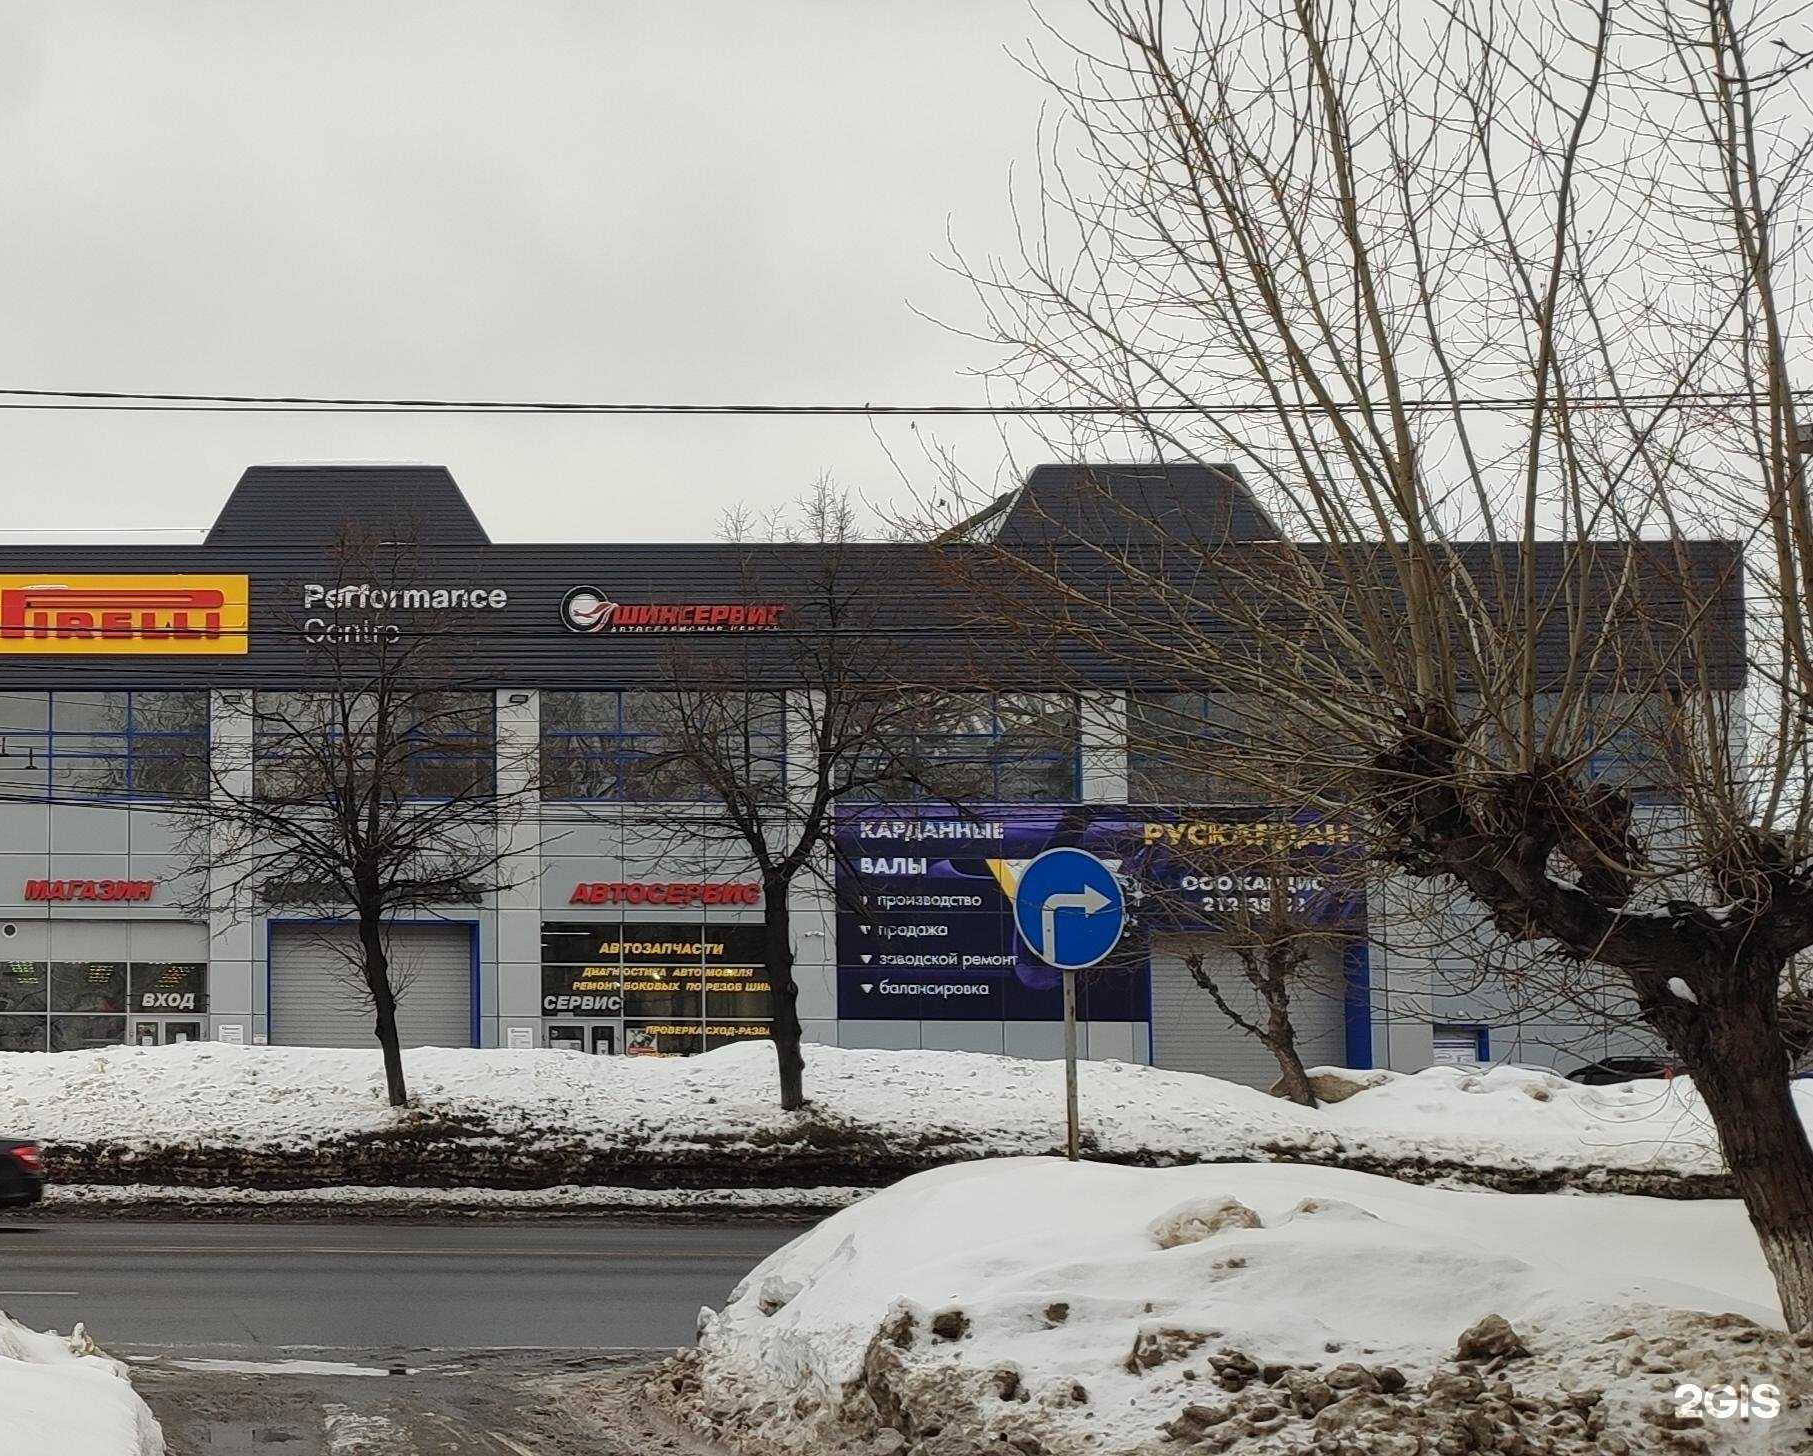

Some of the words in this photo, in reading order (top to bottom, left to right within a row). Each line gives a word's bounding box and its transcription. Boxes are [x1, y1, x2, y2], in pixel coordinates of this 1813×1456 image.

[303, 584, 507, 609] Performance
[1, 589, 225, 639] PIRELLI
[860, 821, 1004, 841] КАРДАННЫЕ
[860, 858, 927, 875] ВАЛЫ
[24, 880, 154, 902] МАГАЗИН
[569, 883, 762, 906] АВТОСЕРВИС
[877, 895, 982, 910] производство
[878, 925, 948, 940] продажа
[599, 942, 724, 956] АВТОЗАПЧАСТИ
[879, 953, 958, 967] заводской
[962, 954, 1019, 970] ремонт
[879, 979, 990, 999] балансировка
[141, 992, 196, 1009] ВХОД
[543, 995, 623, 1011] СЕРВИС
